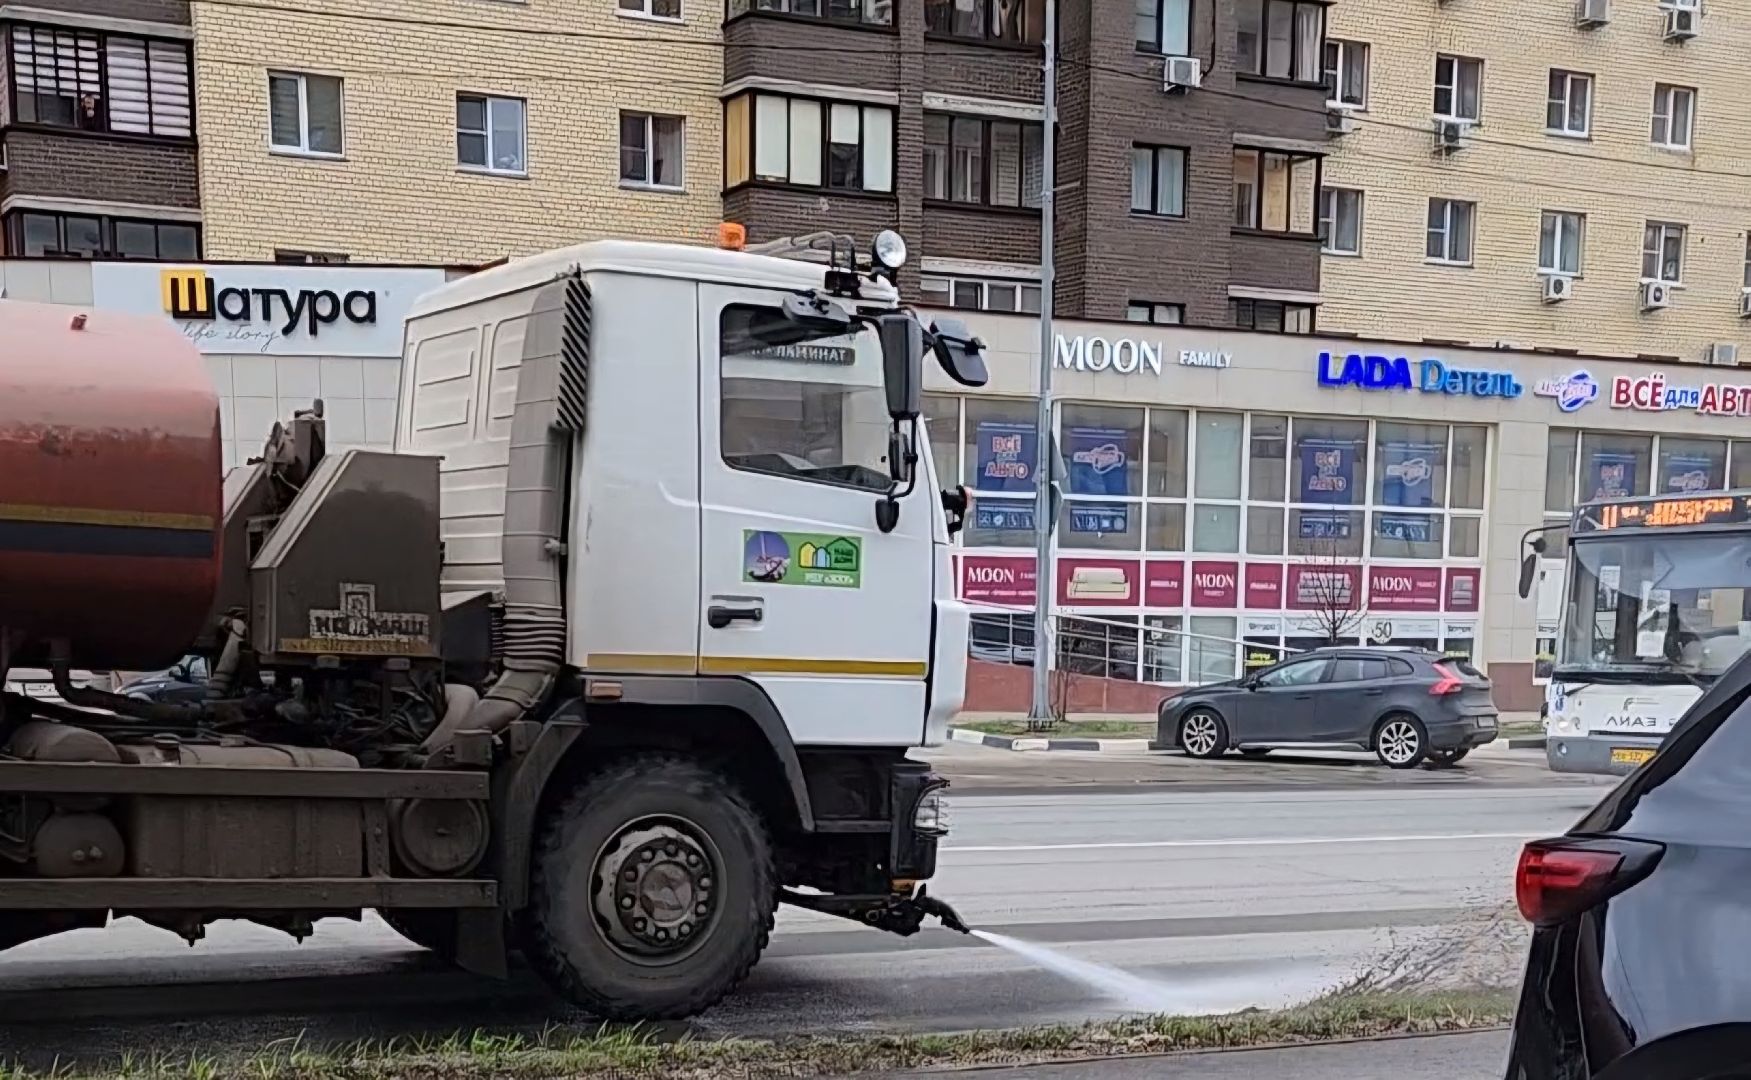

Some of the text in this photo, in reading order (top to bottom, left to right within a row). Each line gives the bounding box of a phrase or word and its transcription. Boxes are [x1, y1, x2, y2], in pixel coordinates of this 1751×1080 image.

[161, 270, 377, 336] Шатура
[226, 324, 282, 352] story
[1053, 334, 1233, 376] MOON FAMILY
[1318, 352, 1413, 389] LADA
[1614, 373, 1665, 409] ВСЁ
[1665, 388, 1699, 406] для
[967, 567, 1015, 583] MOON
[1195, 574, 1234, 589] MOON
[1372, 575, 1412, 592] MOON
